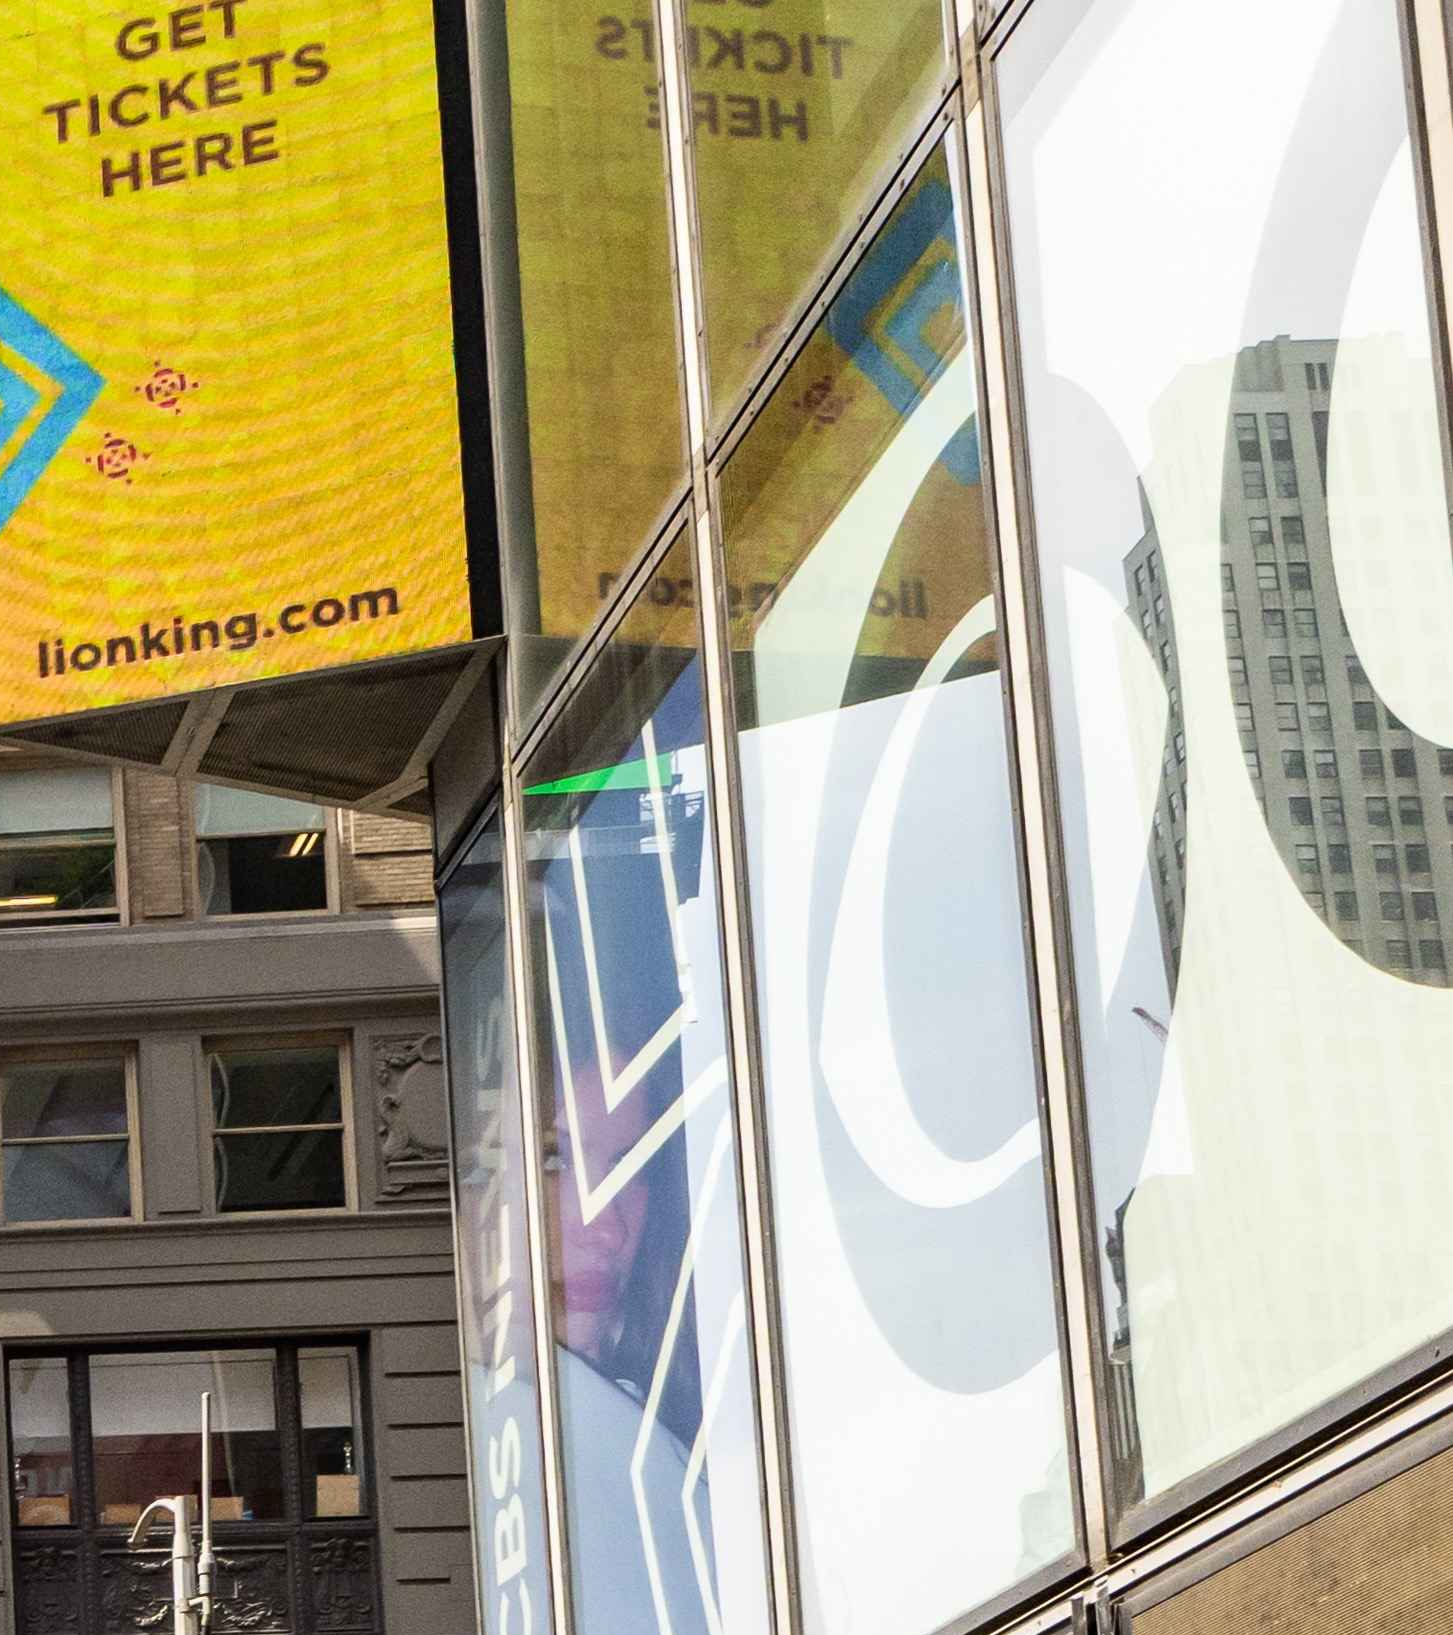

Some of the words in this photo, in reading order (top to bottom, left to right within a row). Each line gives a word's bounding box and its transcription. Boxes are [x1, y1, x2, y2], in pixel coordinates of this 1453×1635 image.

[113, 0, 244, 64] GET
[41, 41, 332, 146] TICKETS
[100, 118, 282, 200] HERE
[36, 585, 402, 681] lionking.com
[486, 1416, 535, 1630] CBS
